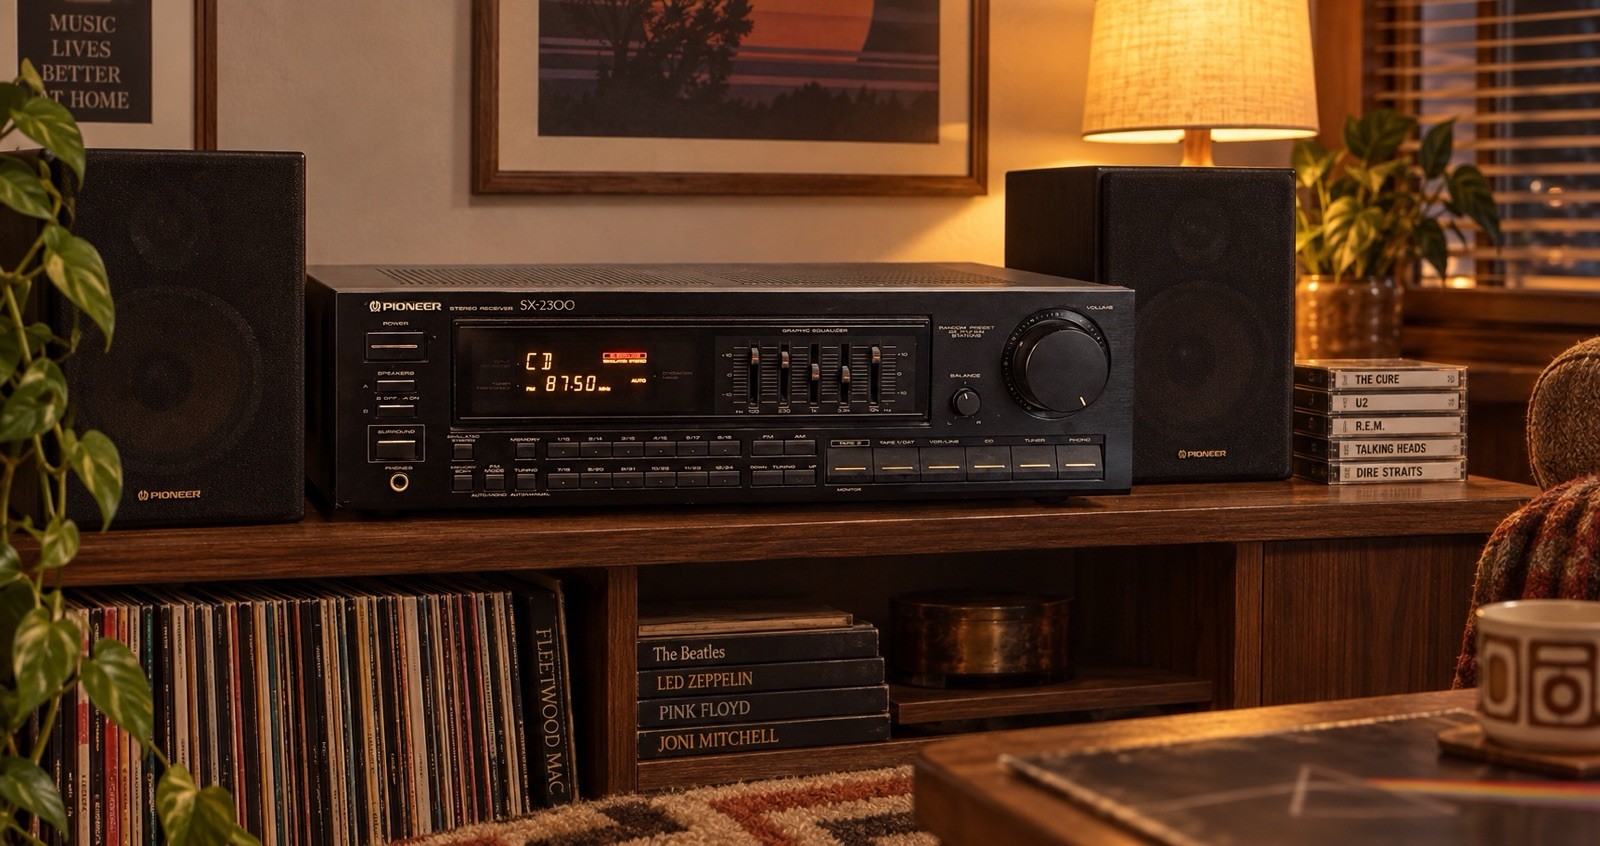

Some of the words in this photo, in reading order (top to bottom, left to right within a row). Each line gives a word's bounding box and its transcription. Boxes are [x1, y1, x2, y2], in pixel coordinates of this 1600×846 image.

[49, 14, 116, 33] MUSIC
[52, 39, 111, 58] LIVES
[42, 64, 122, 84] BETTER
[70, 91, 130, 110] HOME
[383, 302, 442, 311] PIONEER
[520, 300, 576, 310] SX-2300
[526, 352, 552, 370] CD
[546, 375, 596, 392] 87.50
[1356, 375, 1373, 385] THE
[1376, 375, 1400, 384] CURE
[1356, 398, 1368, 408] U2
[1356, 421, 1386, 431] R.E.M.
[1356, 444, 1394, 454] TALKING
[1397, 443, 1426, 454] HEADS
[1356, 468, 1379, 478] DIRE
[1382, 466, 1423, 478] STRAITS
[150, 490, 201, 499] PIONEER
[653, 646, 677, 662] The
[681, 644, 726, 660] Beatles
[536, 627, 560, 748] FLEETWOOD
[658, 675, 684, 691] LED
[688, 671, 753, 689] ZEPPELIN
[659, 703, 696, 720] PINK
[700, 700, 750, 718] FLOYD
[658, 736, 694, 752] JONI
[699, 728, 780, 748] MITCHELL
[546, 752, 564, 795] MAC
